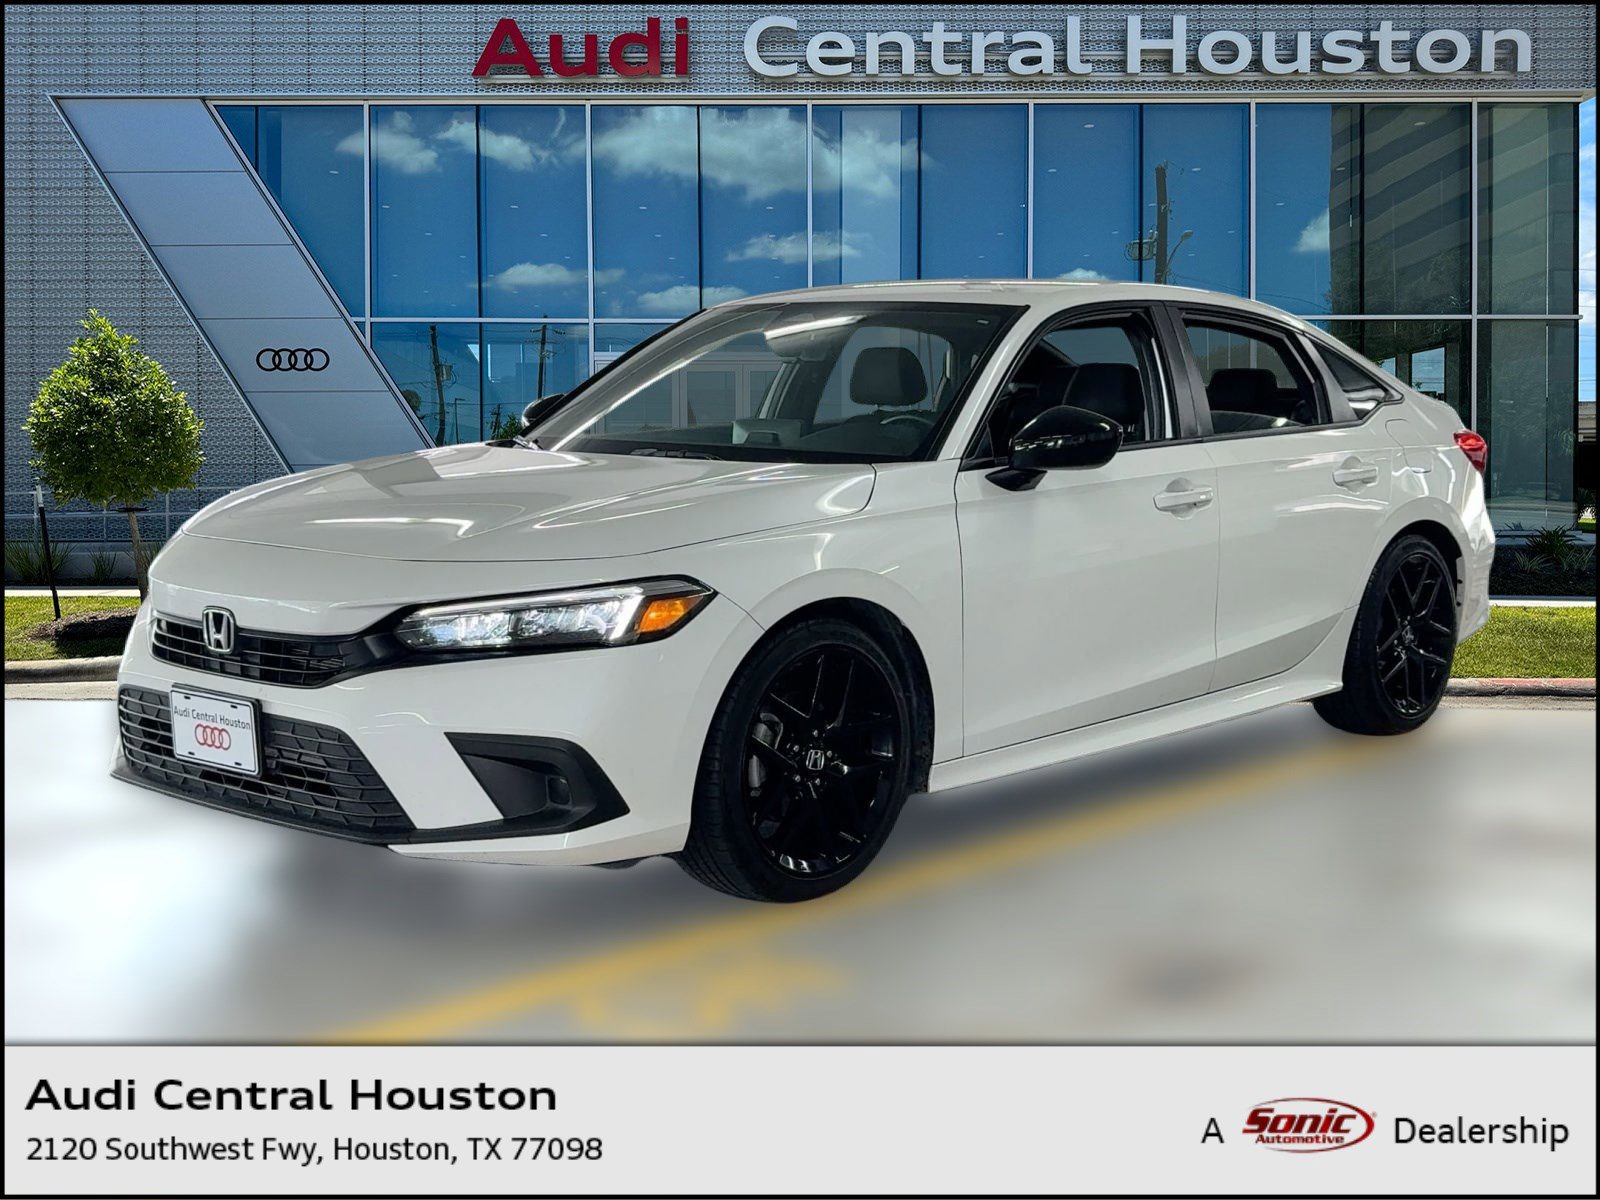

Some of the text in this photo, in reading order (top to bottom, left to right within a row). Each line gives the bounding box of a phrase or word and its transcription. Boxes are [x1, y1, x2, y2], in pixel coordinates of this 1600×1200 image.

[471, 15, 1532, 77] Audi Central Houston
[173, 705, 251, 730] Audi Central Houston
